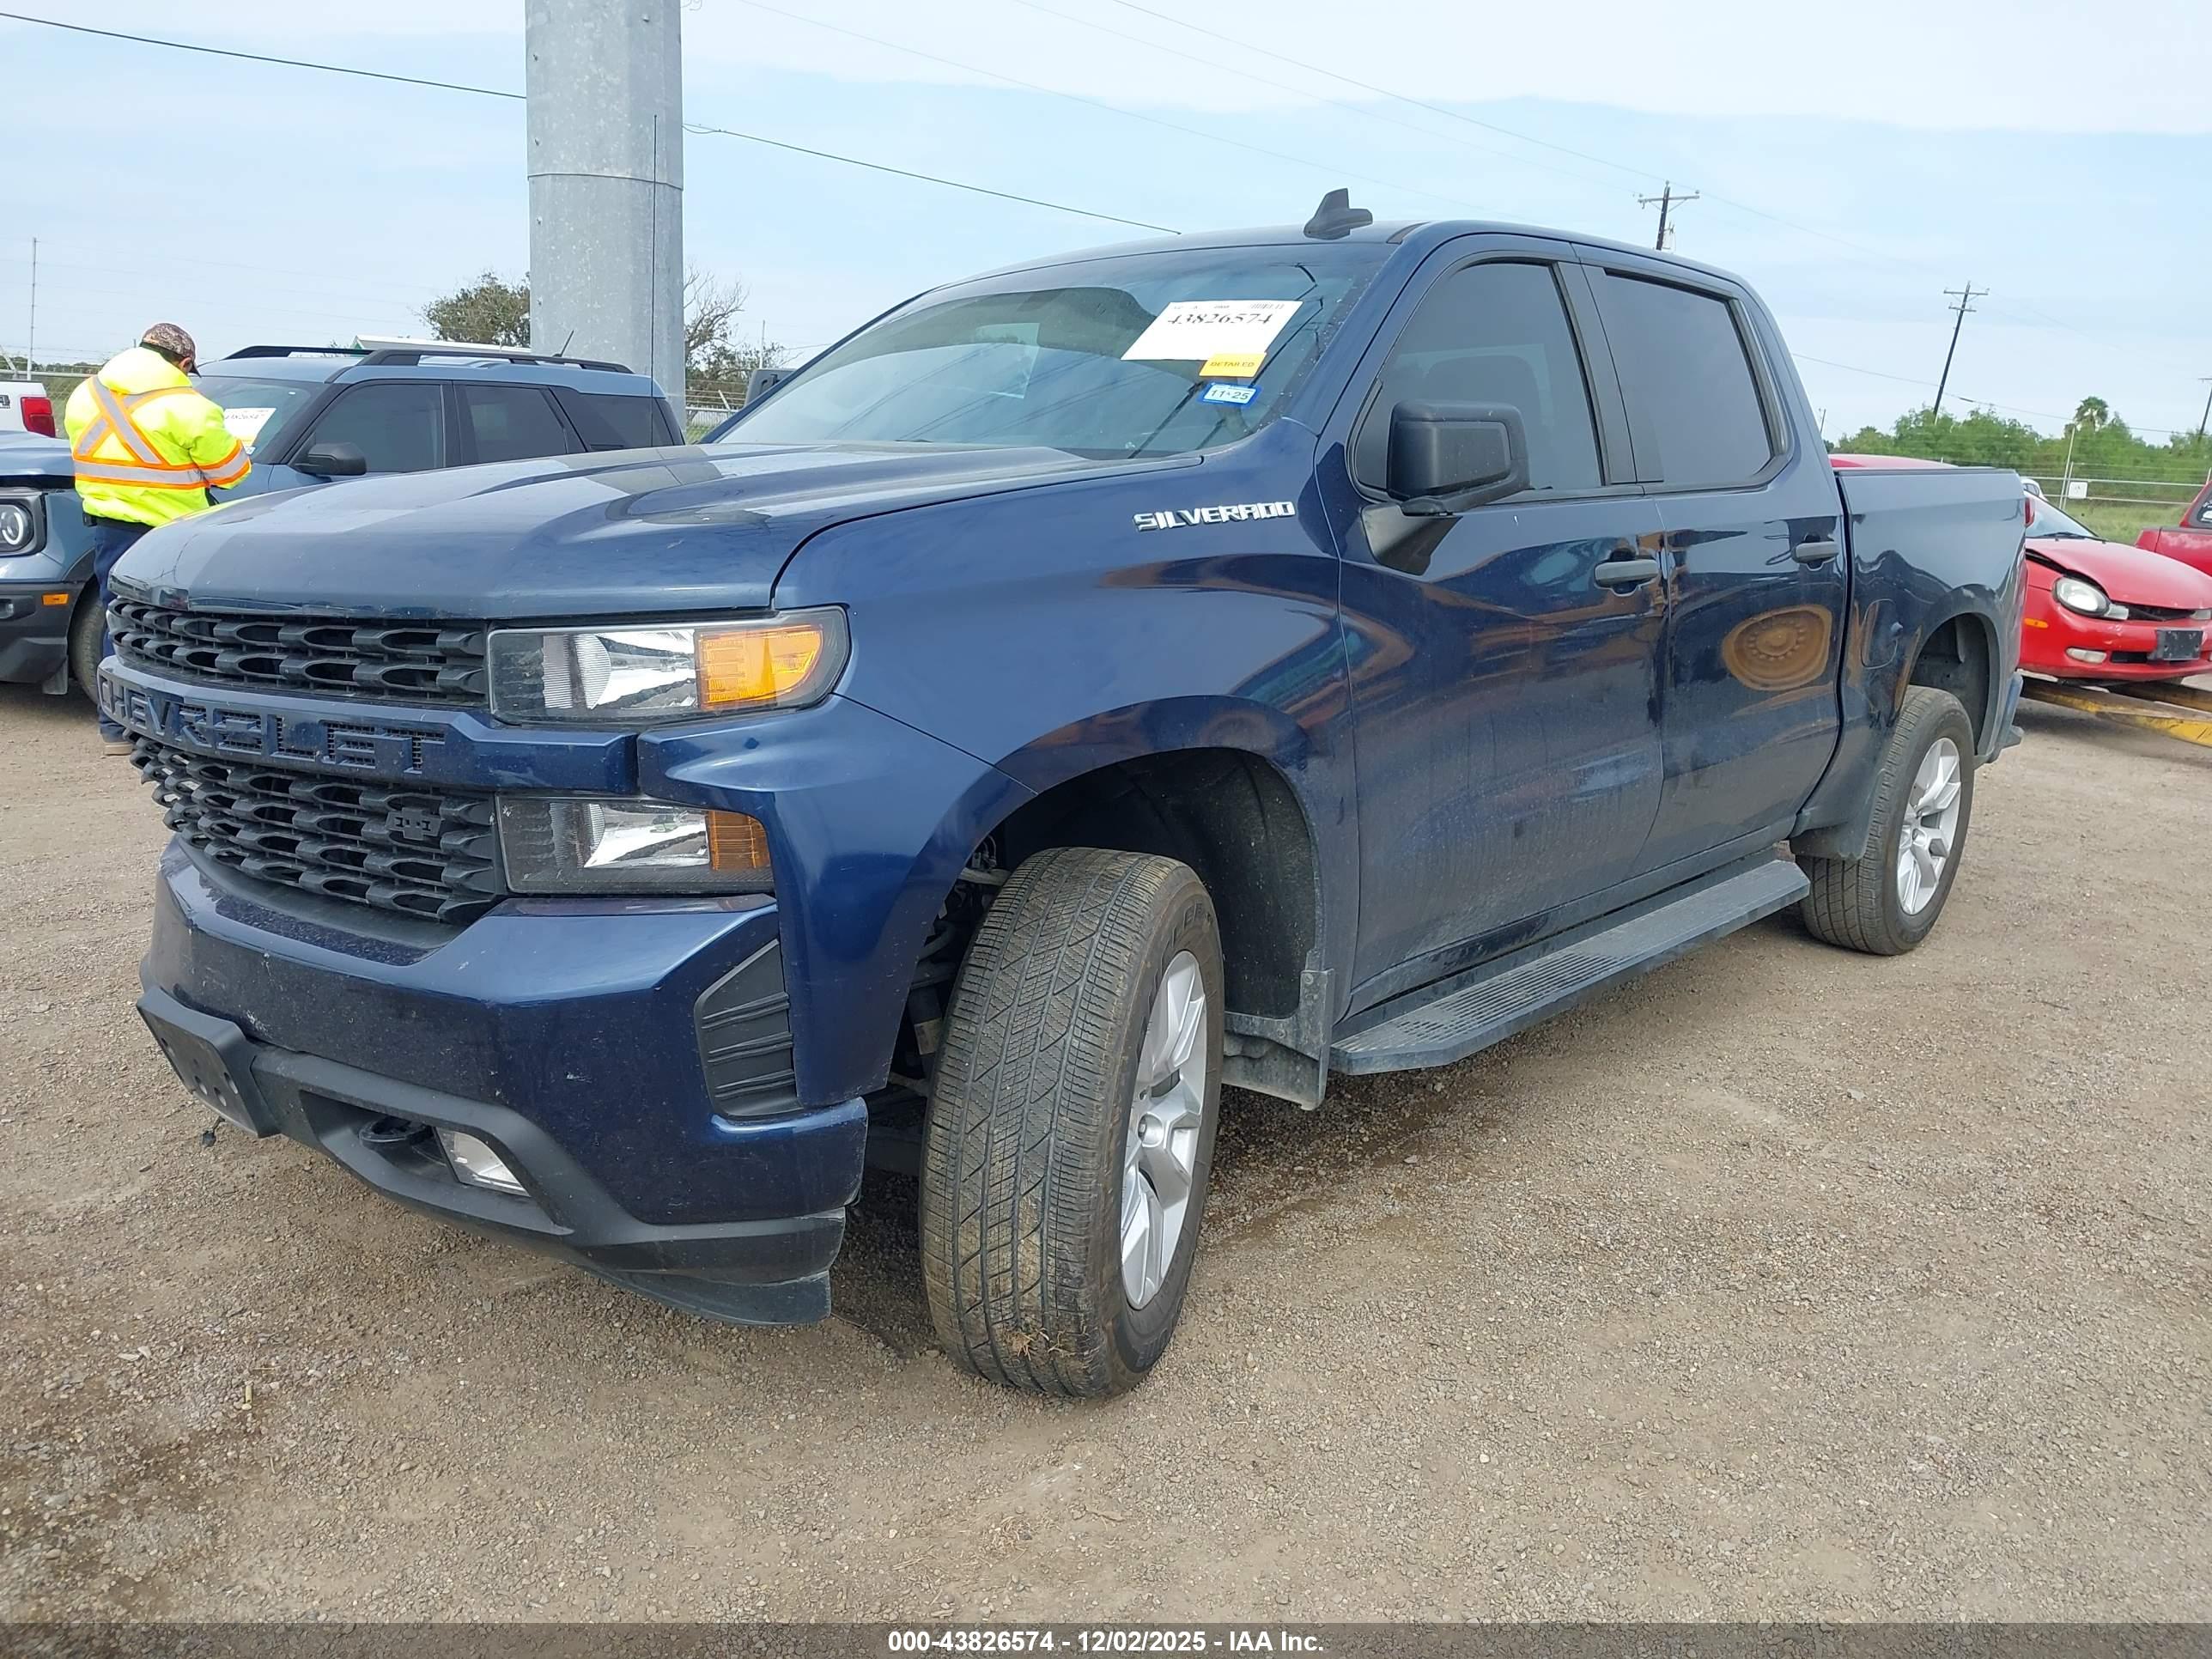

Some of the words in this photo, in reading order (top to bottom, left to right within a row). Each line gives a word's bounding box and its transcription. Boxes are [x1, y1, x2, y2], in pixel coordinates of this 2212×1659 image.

[1168, 313, 1272, 324] 43826574
[1133, 501, 1297, 531] SILVERADO
[100, 674, 446, 773] CHEVROLET
